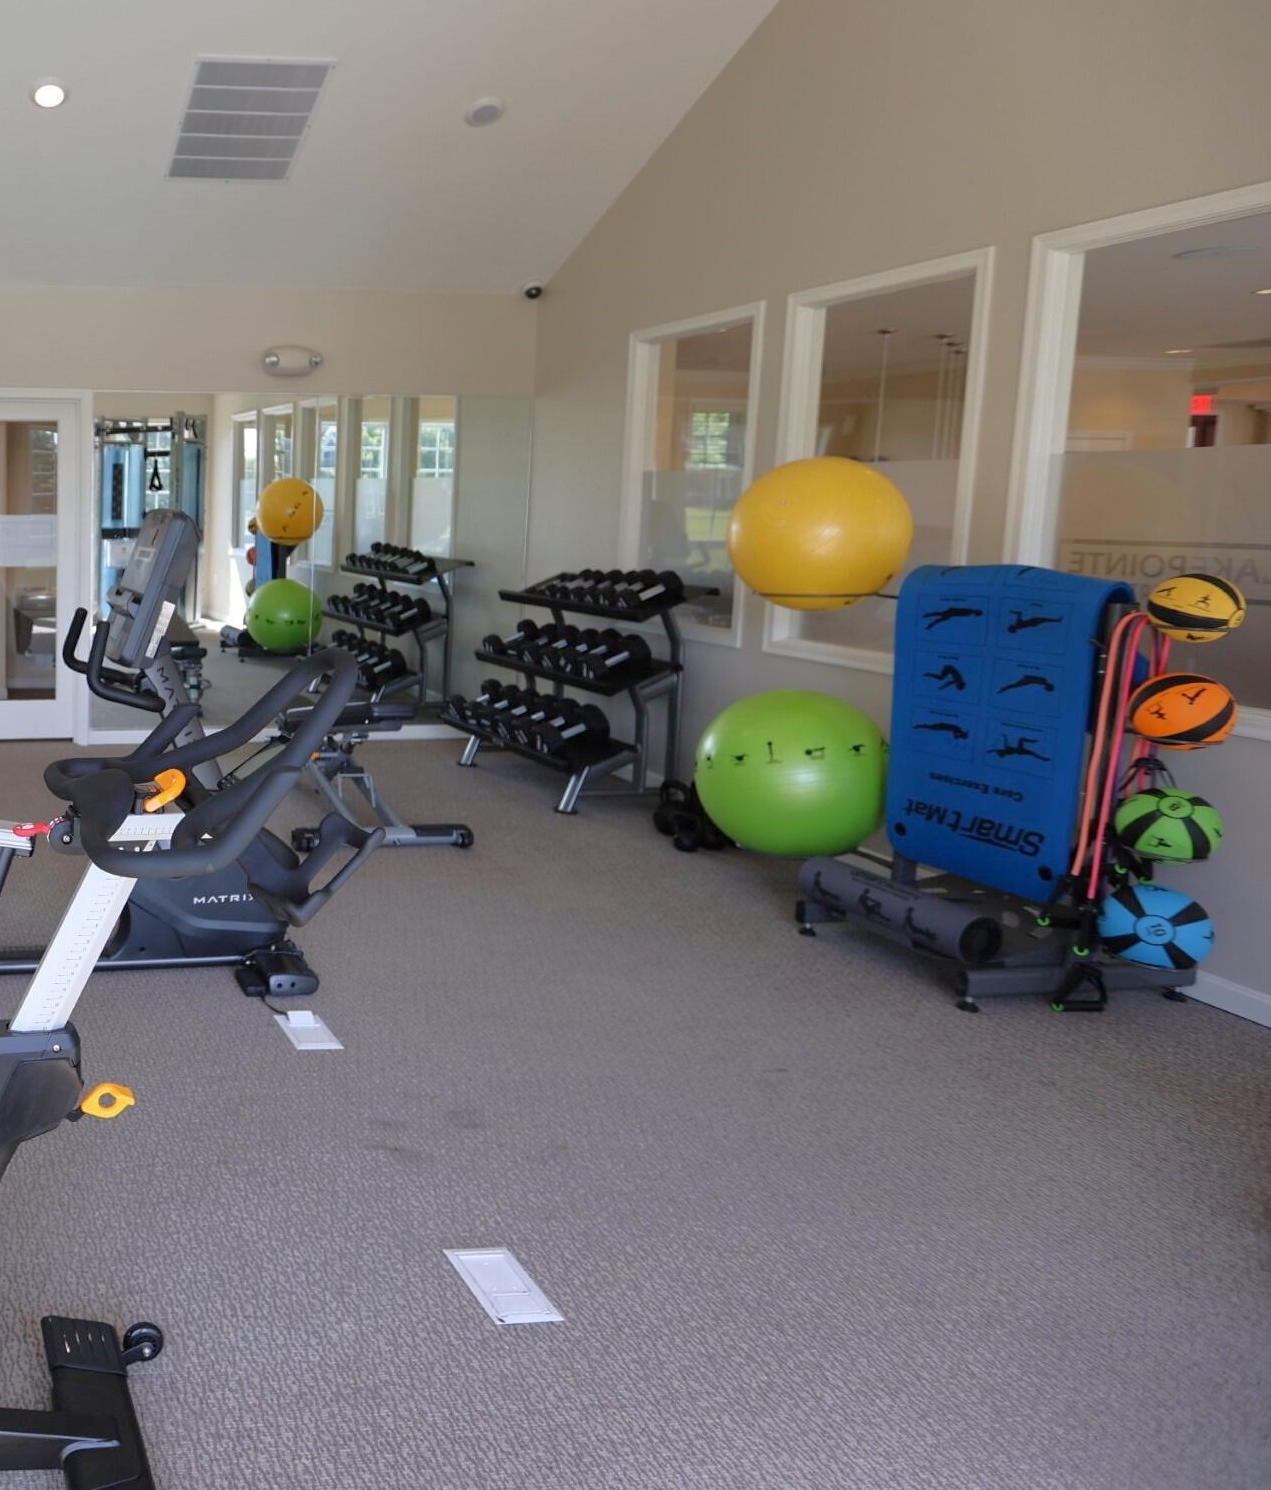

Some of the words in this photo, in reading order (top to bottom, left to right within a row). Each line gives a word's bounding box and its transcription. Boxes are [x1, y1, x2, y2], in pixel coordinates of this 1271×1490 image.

[929, 772, 989, 794] Exercises
[993, 787, 1023, 802] Core
[904, 799, 947, 824] Mat
[947, 811, 1045, 857] Smart
[1150, 923, 1166, 937] 10
